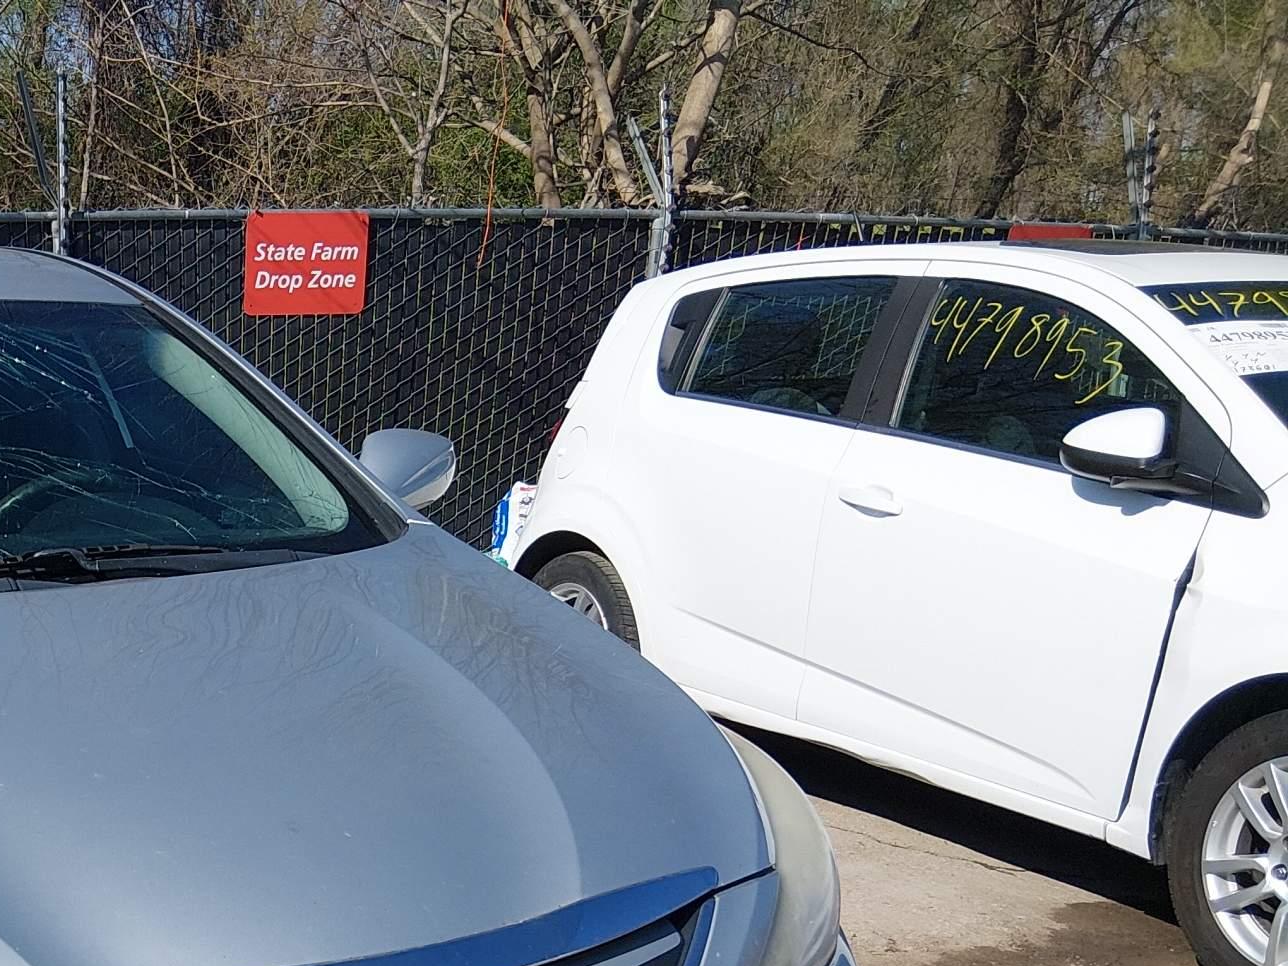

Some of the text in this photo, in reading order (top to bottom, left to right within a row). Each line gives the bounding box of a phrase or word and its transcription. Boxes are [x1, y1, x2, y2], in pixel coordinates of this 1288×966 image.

[253, 242, 359, 261] State Farm
[254, 269, 356, 293] Drop Zone
[931, 296, 1124, 404] 44798953
